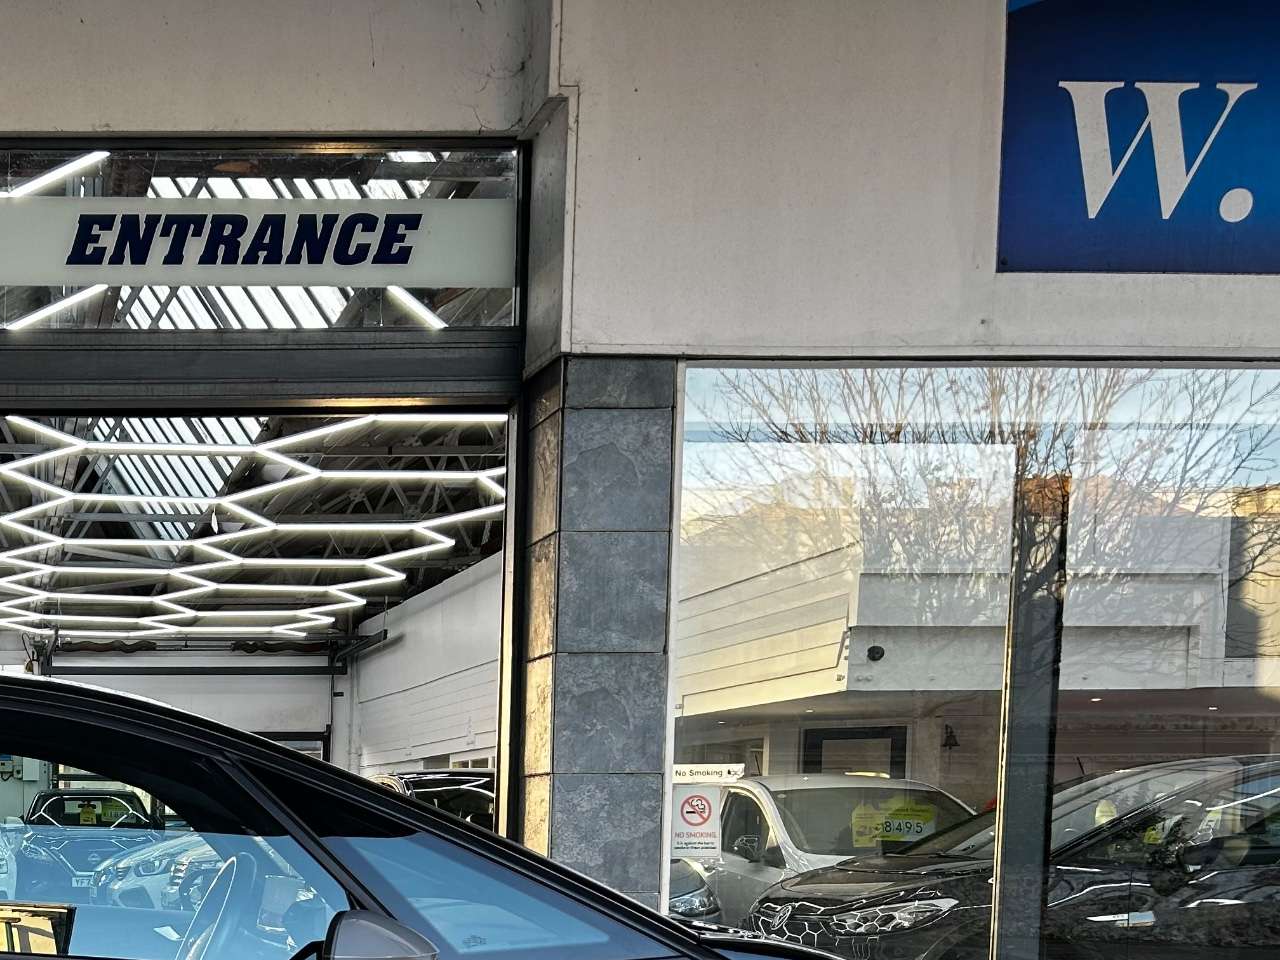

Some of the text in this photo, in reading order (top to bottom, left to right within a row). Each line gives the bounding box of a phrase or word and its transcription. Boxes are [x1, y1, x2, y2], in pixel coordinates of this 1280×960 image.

[1058, 80, 1258, 223] W.
[65, 212, 423, 266] ENTRANCE
[675, 769, 723, 777] No Smoking
[674, 831, 717, 839] NO SMOKING
